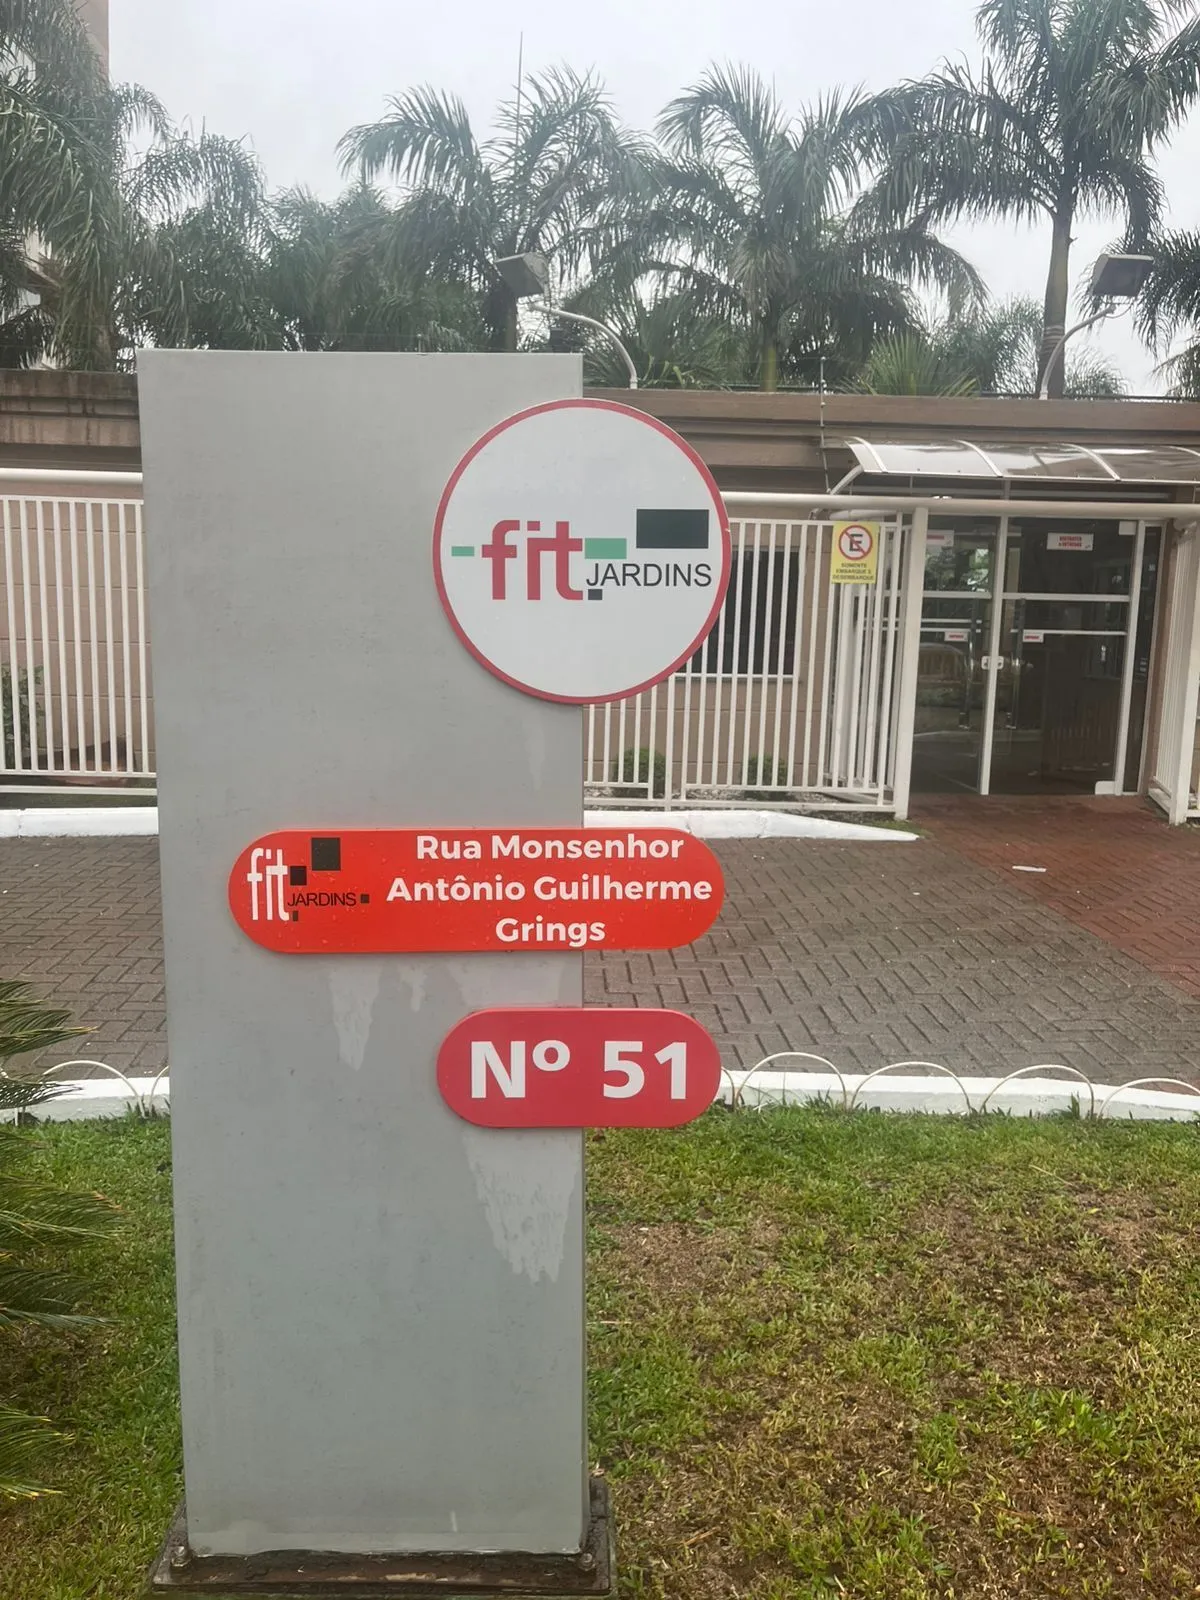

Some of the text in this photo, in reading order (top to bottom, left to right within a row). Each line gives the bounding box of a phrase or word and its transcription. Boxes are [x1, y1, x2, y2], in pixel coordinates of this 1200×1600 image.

[849, 533, 864, 552] E
[586, 562, 712, 588] JARDINS
[416, 833, 685, 860] Rua Monsenhor
[287, 891, 357, 908] JARDINS
[386, 872, 713, 902] Antônio Guilherme
[495, 914, 606, 948] Grings
[471, 1039, 688, 1100] Nº 51
